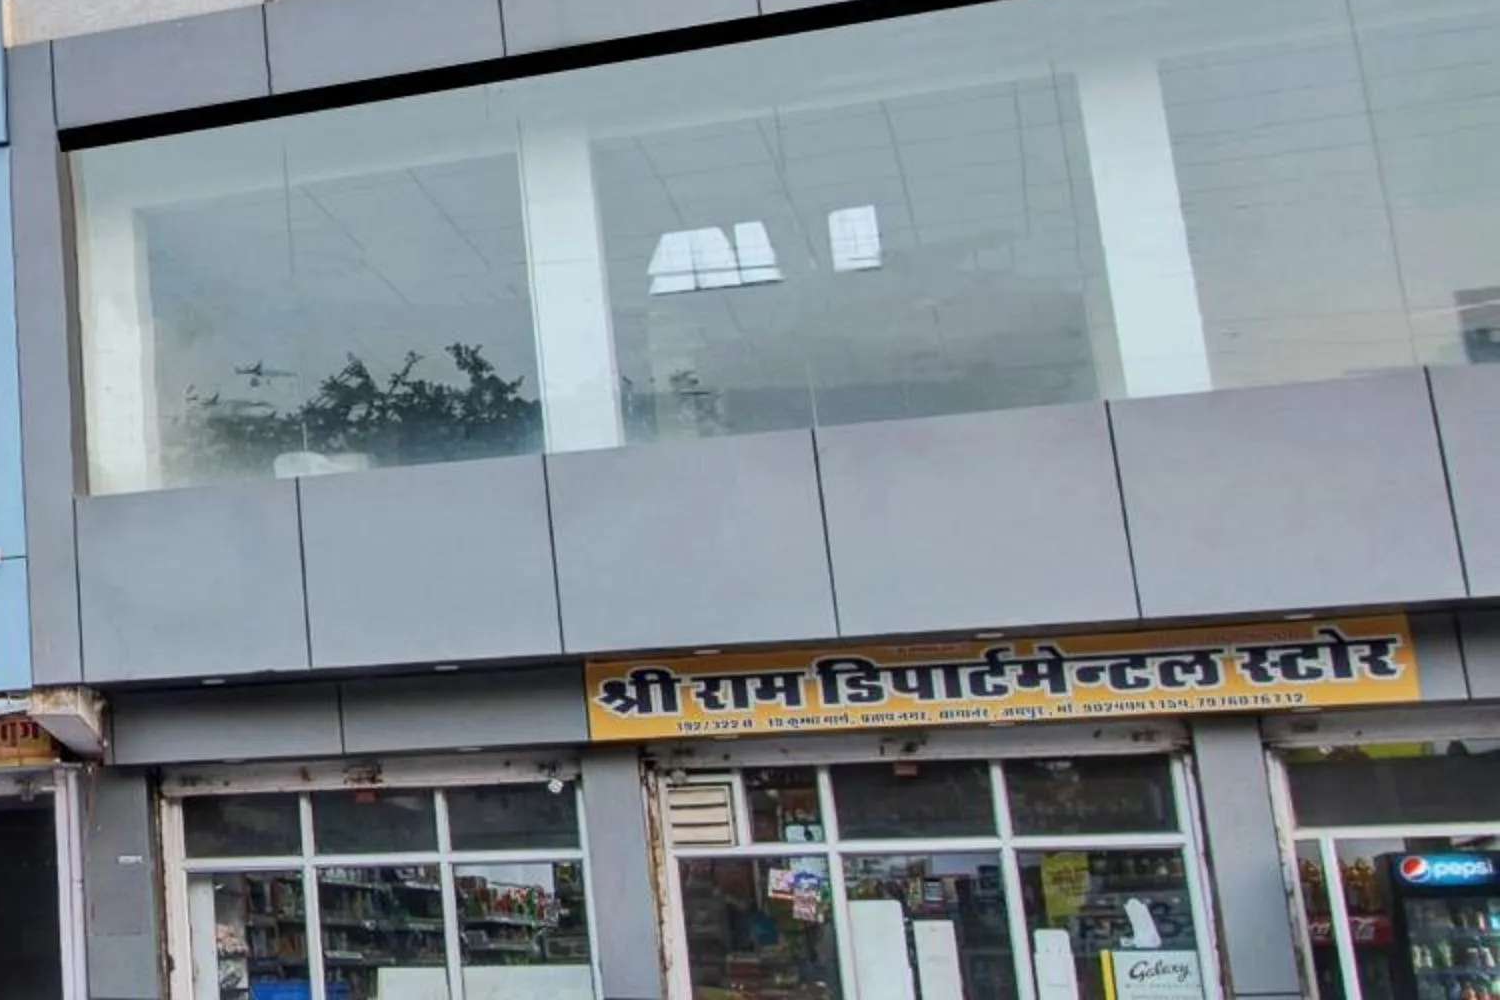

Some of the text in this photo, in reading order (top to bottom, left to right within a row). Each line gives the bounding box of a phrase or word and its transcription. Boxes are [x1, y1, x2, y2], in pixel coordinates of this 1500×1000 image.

[597, 629, 1398, 714] श्री राम डिपार्टमेन्टल स्टोर
[1433, 859, 1493, 880] pepsi
